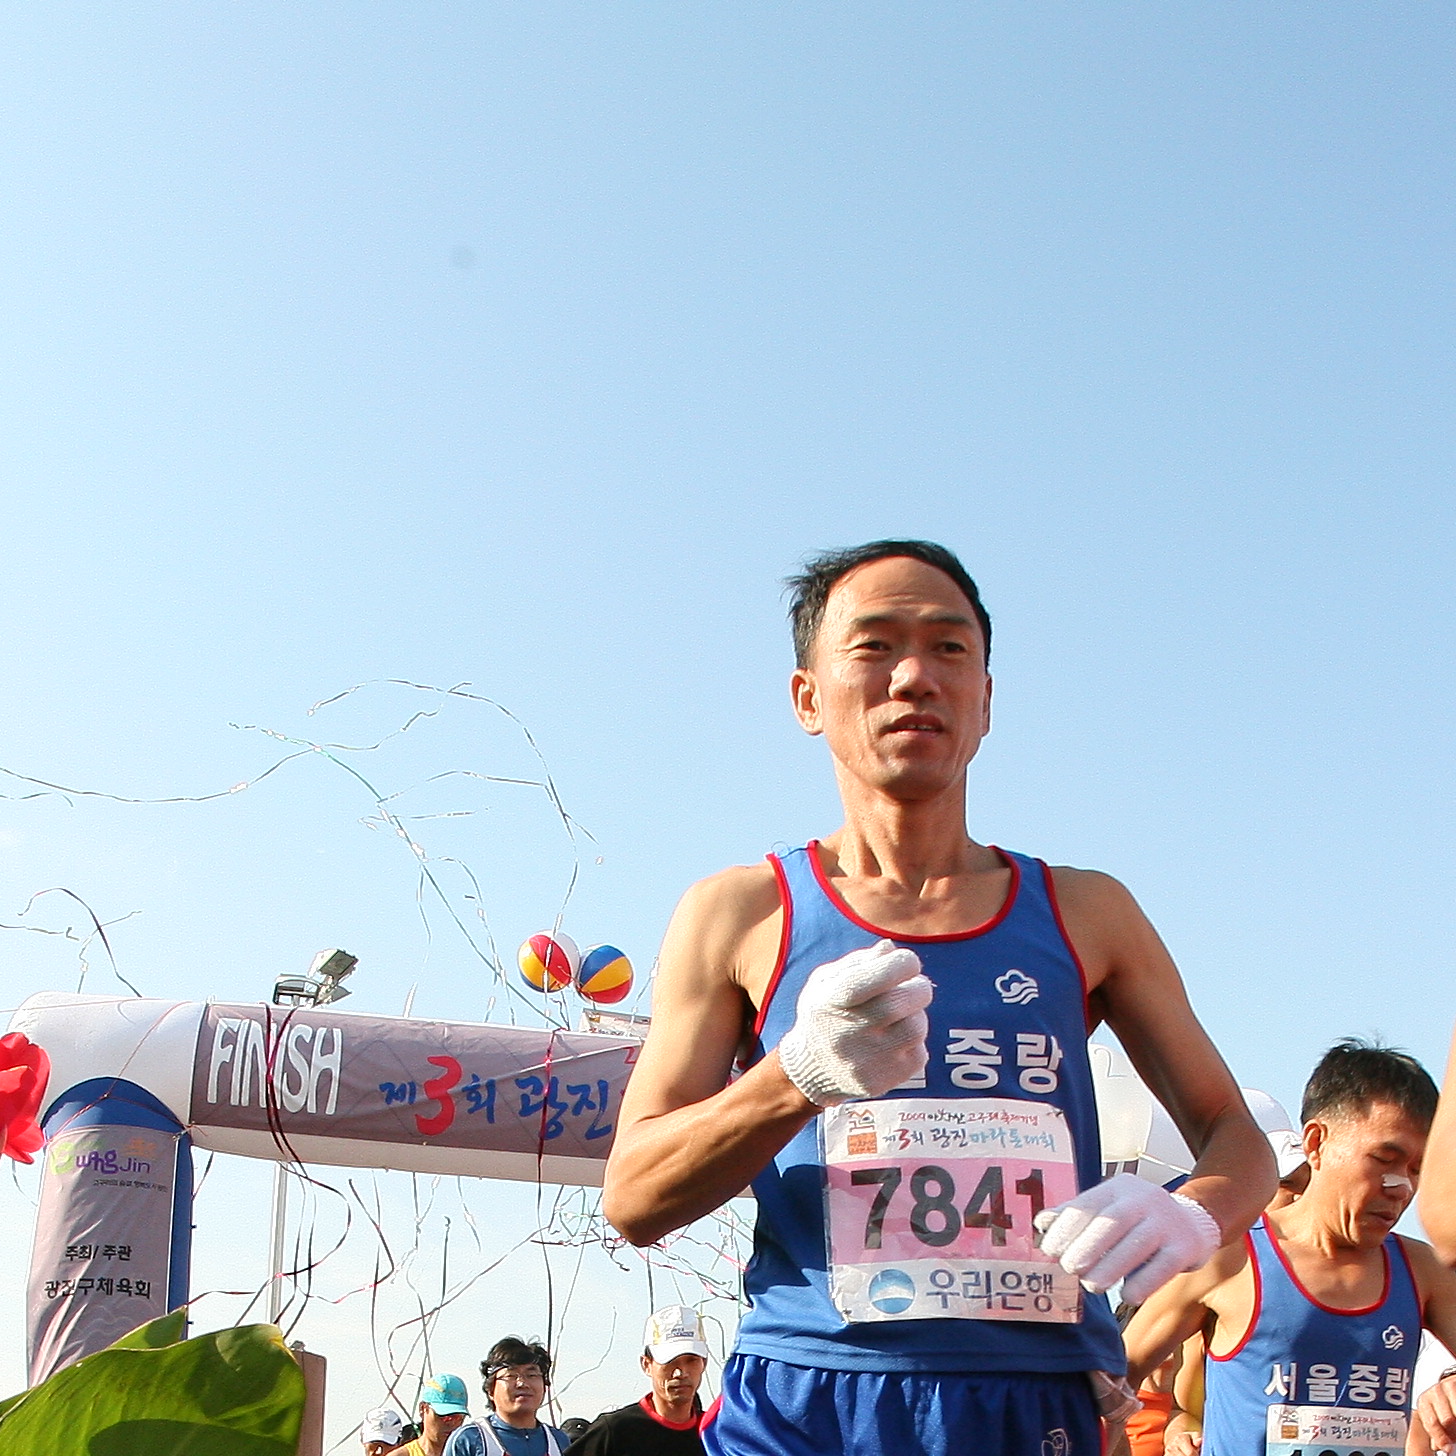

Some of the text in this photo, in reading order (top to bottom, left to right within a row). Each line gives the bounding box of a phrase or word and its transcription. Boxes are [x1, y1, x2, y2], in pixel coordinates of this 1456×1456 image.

[206, 1017, 342, 1115] FINISH
[887, 1028, 1064, 1095] 중랑
[378, 1055, 613, 1141] 제3회 광진
[883, 1128, 924, 1150] 제3회
[930, 1127, 971, 1148] 광진
[850, 1164, 1046, 1251] 7841
[102, 1244, 132, 1262] 주관
[44, 1277, 152, 1300] 광진구체육회
[926, 1268, 1054, 1313] 우리은행
[1264, 1362, 1410, 1407] 서울중랑
